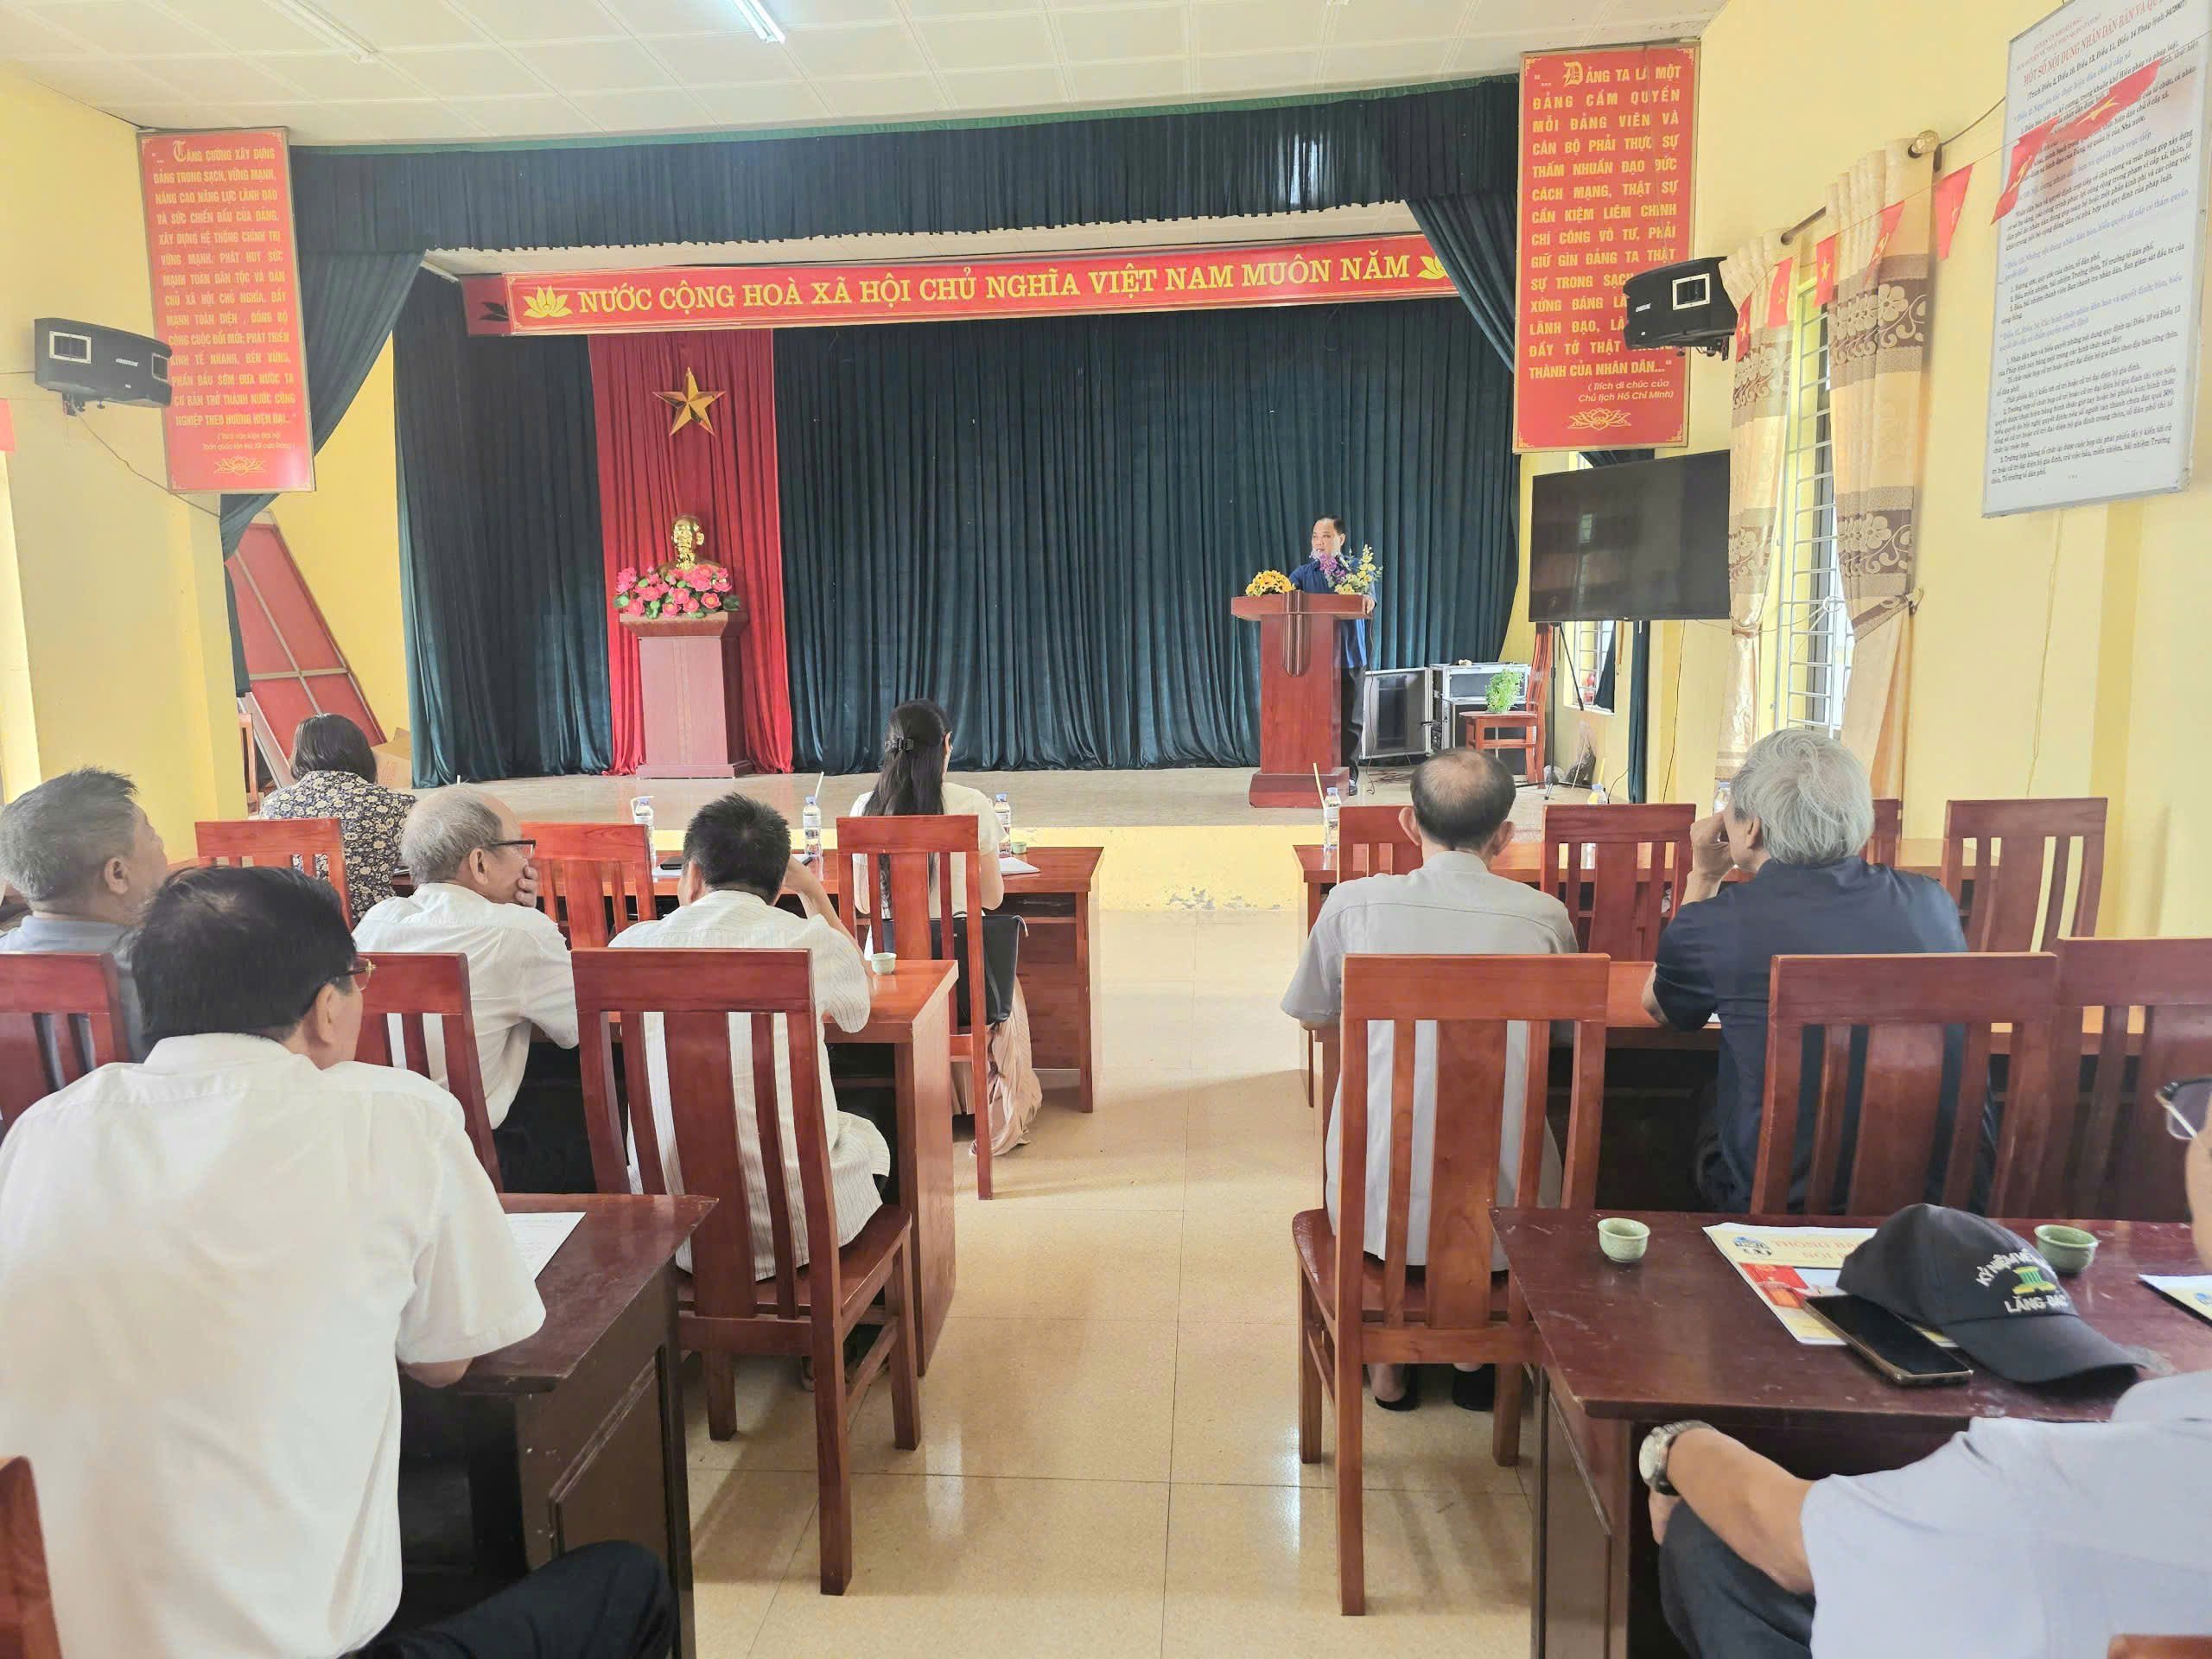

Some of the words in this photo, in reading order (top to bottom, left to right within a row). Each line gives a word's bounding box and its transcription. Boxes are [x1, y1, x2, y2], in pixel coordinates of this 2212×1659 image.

[1616, 69, 1630, 81] TA
[1656, 66, 1681, 81] MỘT
[1533, 92, 1573, 110] ĐẢNG
[1586, 89, 1618, 106] CẦM
[1630, 86, 1680, 105] QUYỀN
[1533, 115, 1558, 132] MỖI
[1570, 112, 1607, 130] ĐẢNG
[1619, 112, 1650, 127] VIÊN
[1662, 110, 1678, 124] VÀ
[235, 147, 250, 160] XÂY
[1533, 141, 1556, 155] CÁN
[1565, 139, 1580, 155] BỘ
[1589, 134, 1616, 152] PHẢI
[1624, 137, 1652, 151] THỰC
[1662, 135, 1680, 149] SỰ
[154, 168, 175, 184] ĐẢNG
[176, 171, 201, 183] TRONG
[1532, 161, 1564, 178] THẤM
[1573, 158, 1613, 175] NHUẦN
[1621, 160, 1644, 175] ĐẠO
[1656, 156, 1677, 171] ĐỨC
[180, 193, 194, 204] CAO
[1532, 185, 1562, 200] CÁCH
[1573, 185, 1611, 200] MẠNG,
[1623, 181, 1651, 198] THẬT
[1662, 180, 1679, 194] SỰ
[1532, 208, 1555, 223] CẦN
[1565, 207, 1593, 223] KIỆM
[1604, 204, 1630, 219] LIÊM
[1531, 230, 1550, 245] CHÍ
[1559, 229, 1590, 245] CÔNG
[1599, 229, 1613, 242] VÔ
[1649, 221, 1675, 238] PHẢI
[1531, 253, 1552, 269] GIỮ
[1558, 251, 1578, 267] GÌN
[1586, 248, 1618, 265] ĐẢNG
[1625, 251, 1638, 263] TA
[1648, 248, 1675, 264] THẬT
[578, 283, 653, 313] NƯỚC
[659, 279, 734, 316] CỘNG
[743, 276, 804, 307] HOÀ
[810, 276, 852, 305] XÃ
[859, 272, 911, 308] HỘI
[918, 267, 976, 301] CHỦ
[986, 267, 1079, 299] NGHĨA
[1090, 263, 1156, 298] VIỆT
[1166, 265, 1234, 290] NAM
[1242, 254, 1331, 287] MUÔN
[1339, 251, 1409, 282] NĂM
[1531, 276, 1548, 293] SỰ
[1556, 276, 1593, 289] TRONG
[1530, 296, 1561, 312] XỨNG
[1572, 296, 1604, 310] ĐÁNG
[1529, 321, 1561, 335] LÃNH
[1572, 320, 1599, 334] ĐẠO,
[1529, 342, 1554, 357] ĐẦY
[1565, 341, 1580, 355] TỚ
[1590, 340, 1620, 355] THẬT
[1529, 365, 1566, 378] THÀNH
[1570, 360, 1592, 376] CỦA
[1596, 362, 1627, 375] NHÂN
[1627, 380, 1648, 389] chúc
[1651, 379, 1669, 388] của
[1599, 393, 1614, 403] lịch
[1618, 391, 1629, 400] Hồ
[1633, 391, 1646, 400] Chí
[2005, 1295, 2046, 1313] LĂNG
